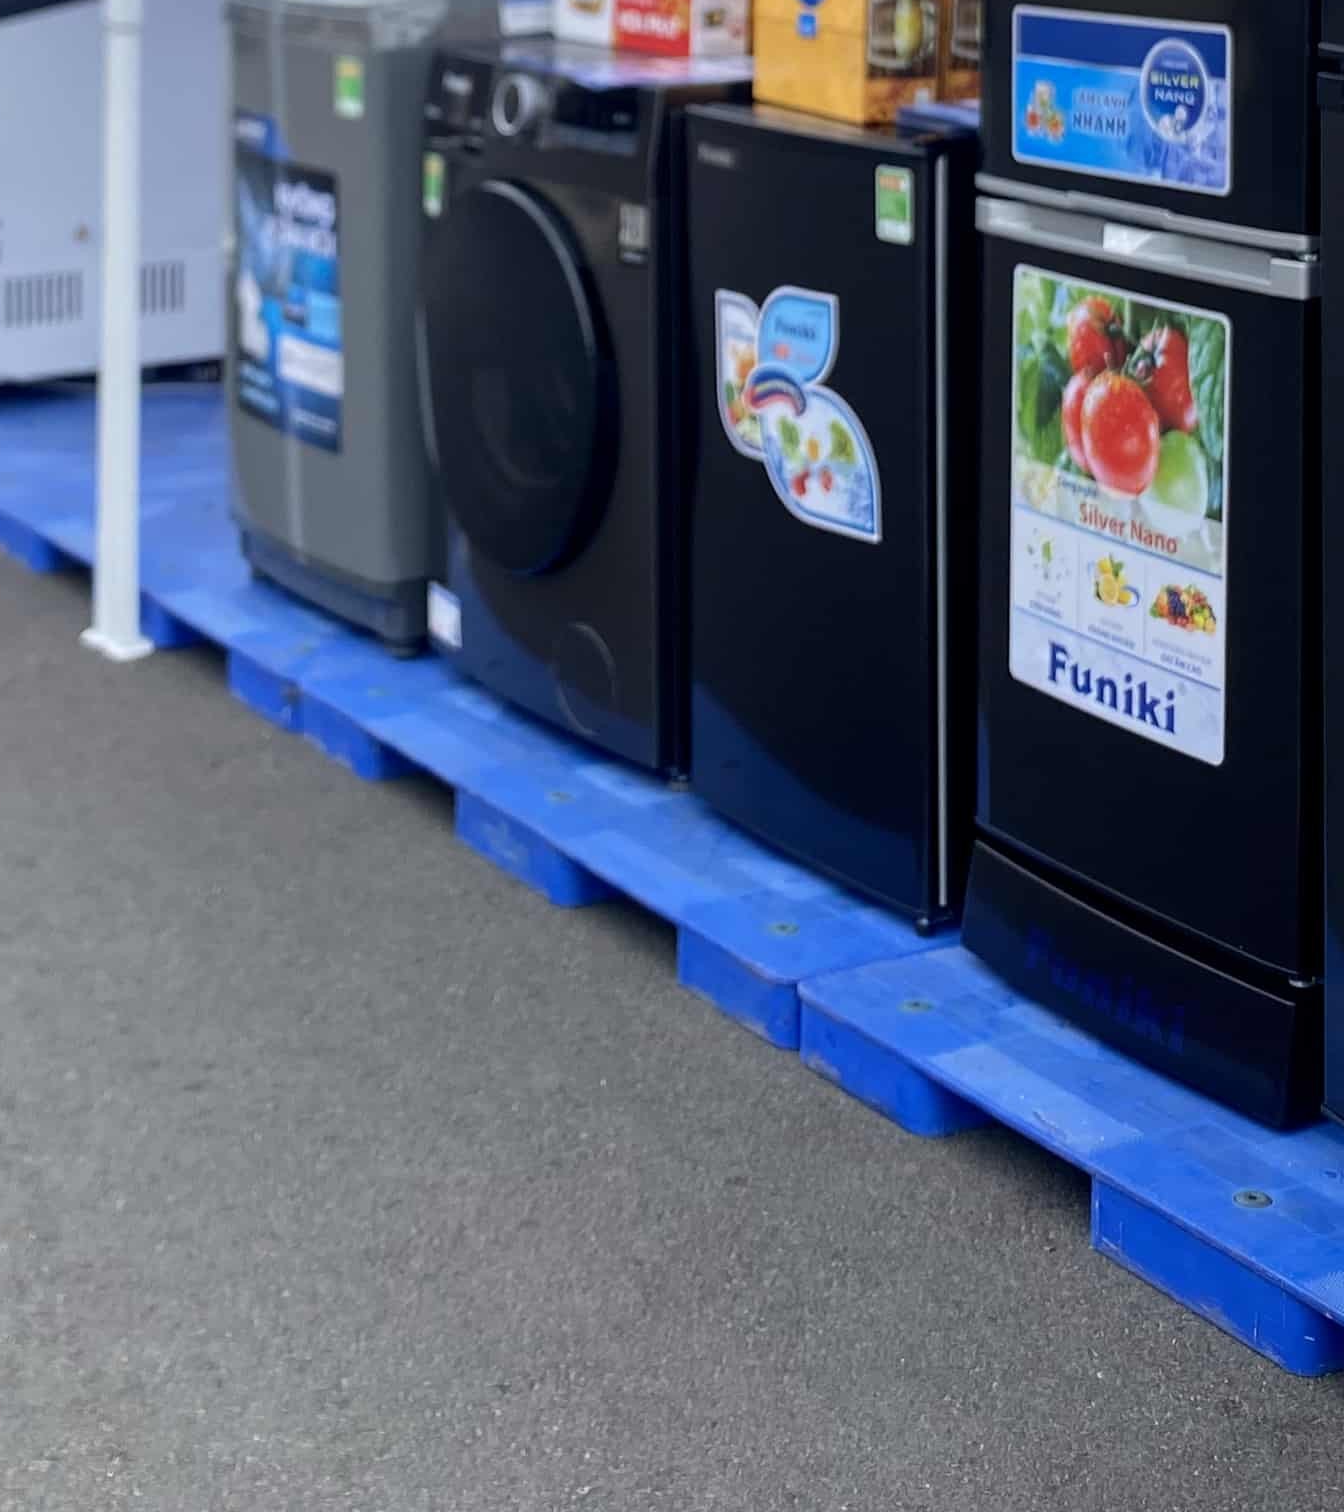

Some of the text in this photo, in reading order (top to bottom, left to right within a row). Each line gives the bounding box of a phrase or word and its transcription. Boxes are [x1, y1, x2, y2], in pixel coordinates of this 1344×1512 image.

[1150, 71, 1200, 89] SILVER
[1154, 87, 1195, 106] NANO
[1079, 501, 1177, 554] Silver Nano
[1048, 640, 1177, 734] Funiki
